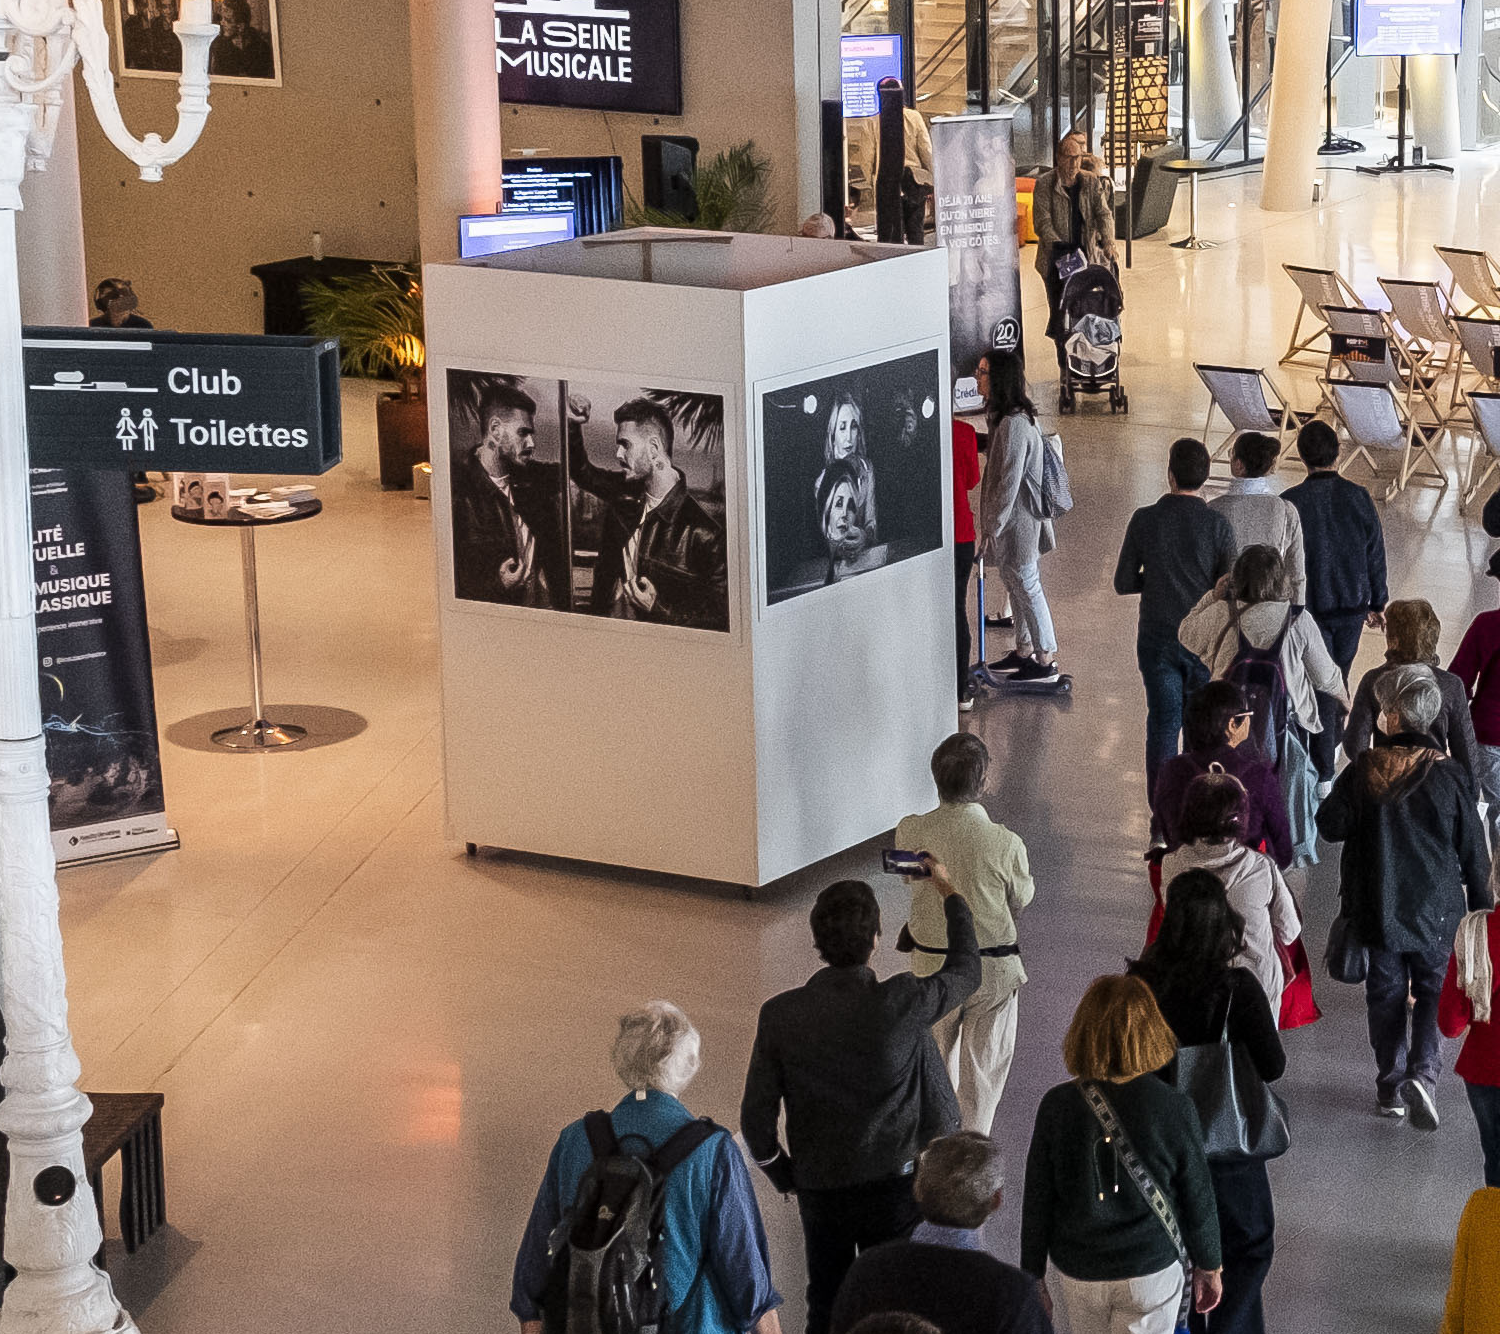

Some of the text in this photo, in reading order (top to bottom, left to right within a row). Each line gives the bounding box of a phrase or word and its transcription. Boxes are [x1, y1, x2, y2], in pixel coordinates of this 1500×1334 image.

[494, 17, 632, 52] LA SEINE
[495, 48, 633, 84] MUSICALE
[969, 207, 997, 219] VIBRE
[940, 221, 994, 236] EN MUSIQUE
[949, 237, 968, 248] VOS
[167, 366, 242, 396] Club
[954, 387, 978, 399] Crédi
[168, 417, 309, 448] Toilettes
[35, 573, 111, 596] MUSIQUE
[35, 591, 113, 615] ASSIQUE
